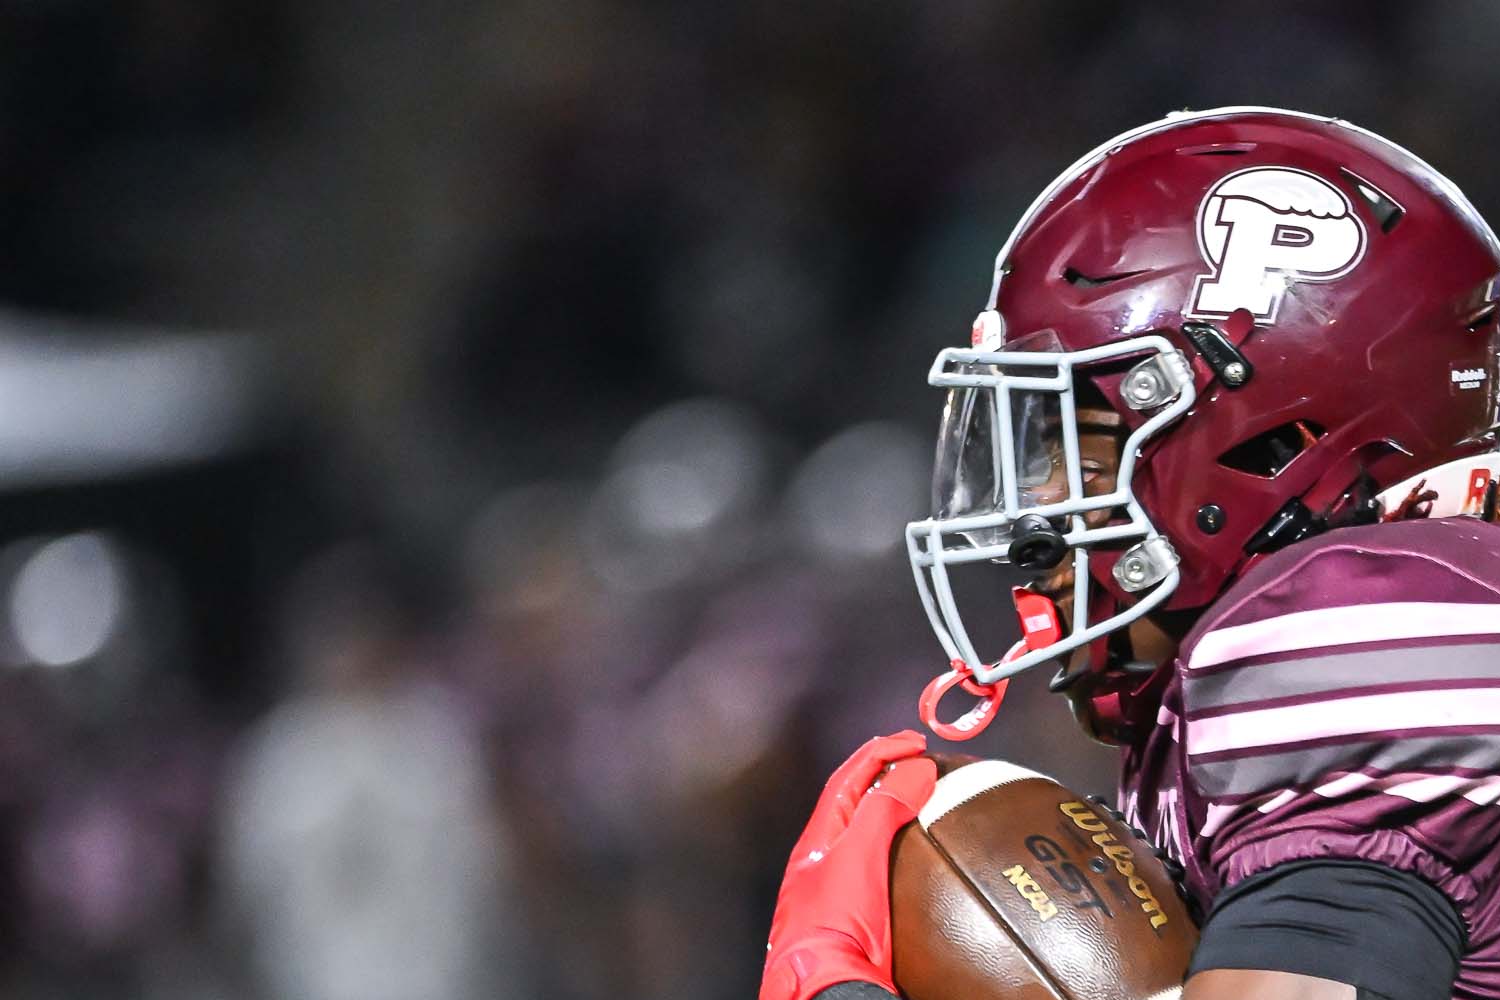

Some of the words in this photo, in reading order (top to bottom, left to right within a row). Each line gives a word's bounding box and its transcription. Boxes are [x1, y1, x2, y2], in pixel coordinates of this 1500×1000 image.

[1185, 168, 1367, 325] P
[1001, 864, 1058, 922] NCAA
[1023, 834, 1115, 919] GST
[1059, 801, 1169, 930] Wilson
